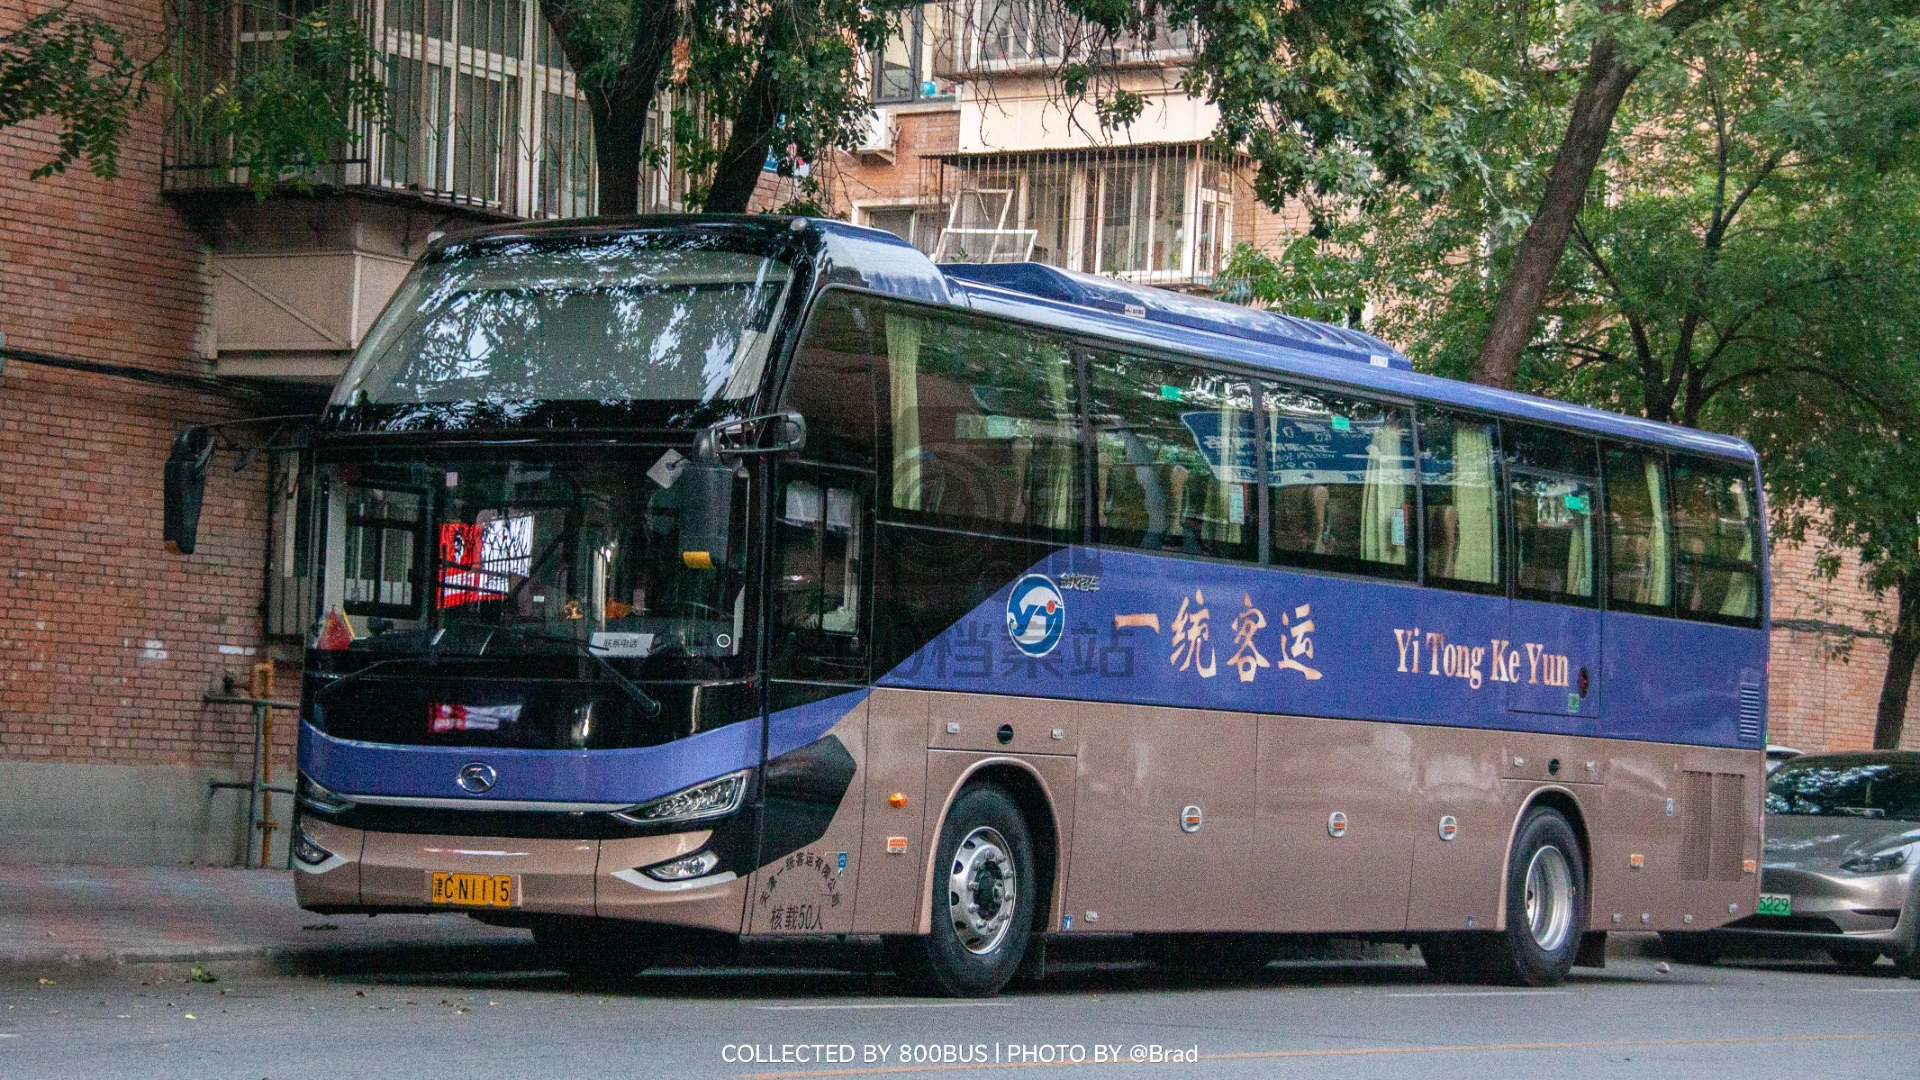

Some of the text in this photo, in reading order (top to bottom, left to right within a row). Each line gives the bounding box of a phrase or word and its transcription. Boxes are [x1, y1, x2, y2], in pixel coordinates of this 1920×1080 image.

[603, 638, 639, 649] 联系电话
[1115, 588, 1323, 682] 一统客运
[1394, 627, 1569, 690] Yi Tong Ke Yun
[770, 904, 823, 931] 核载50人
[1759, 896, 1789, 912] 5229
